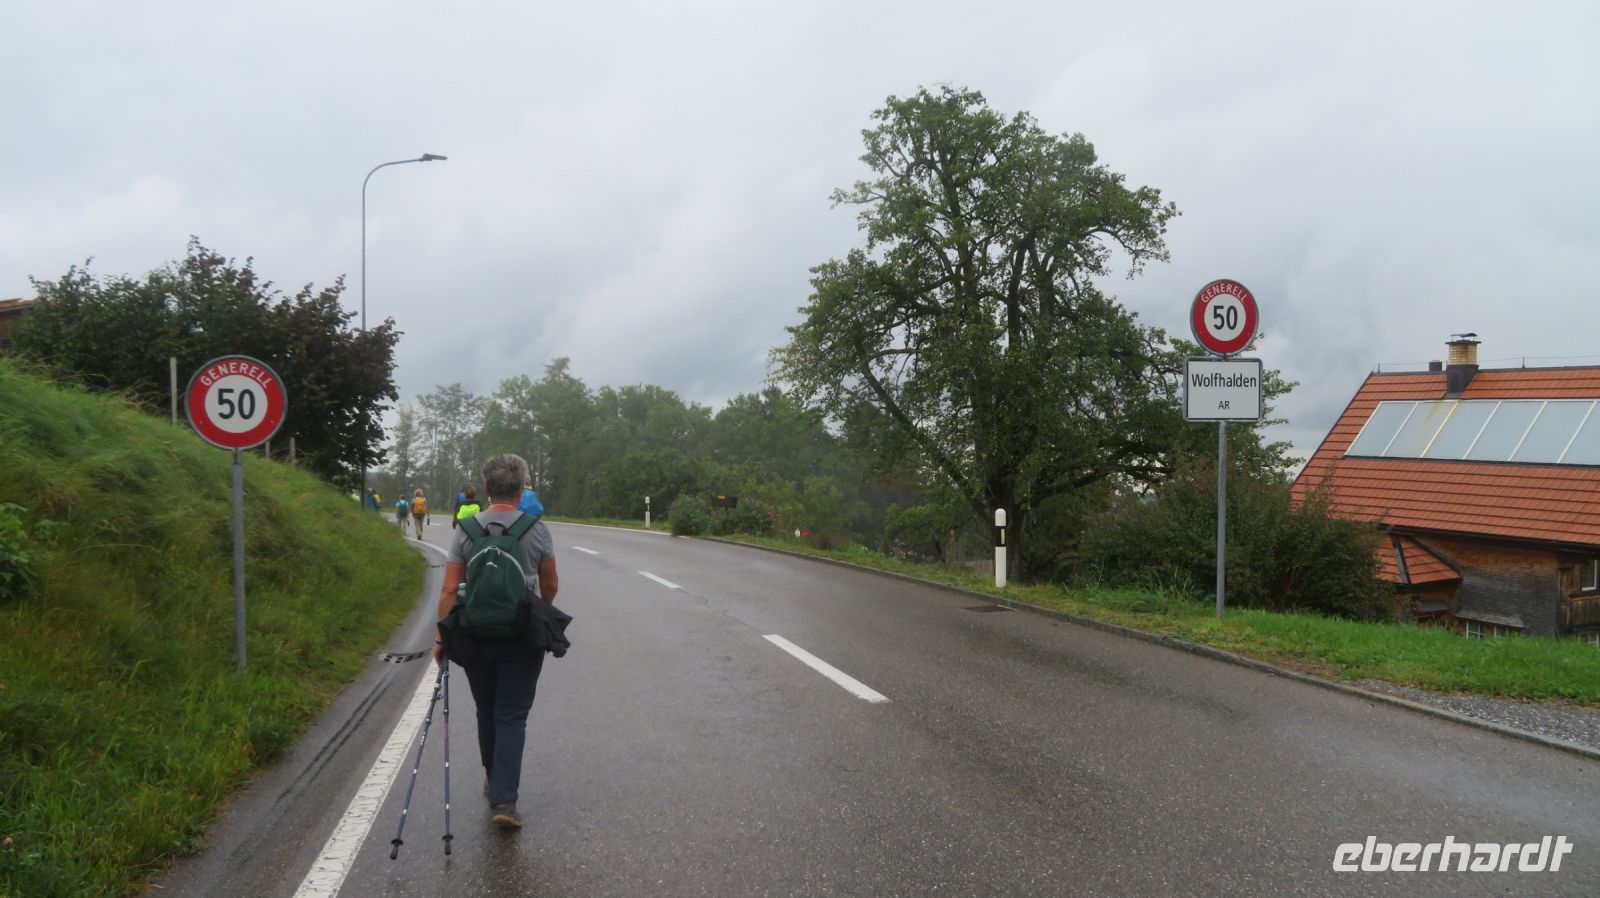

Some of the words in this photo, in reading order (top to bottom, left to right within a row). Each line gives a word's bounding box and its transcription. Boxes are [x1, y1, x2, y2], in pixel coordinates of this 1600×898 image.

[1201, 283, 1248, 303] GENERELL
[1213, 305, 1238, 330] 50
[200, 362, 273, 389] GENERELL
[1191, 373, 1257, 388] Wolfhalden
[218, 388, 256, 420] 50
[1218, 400, 1230, 410] AR
